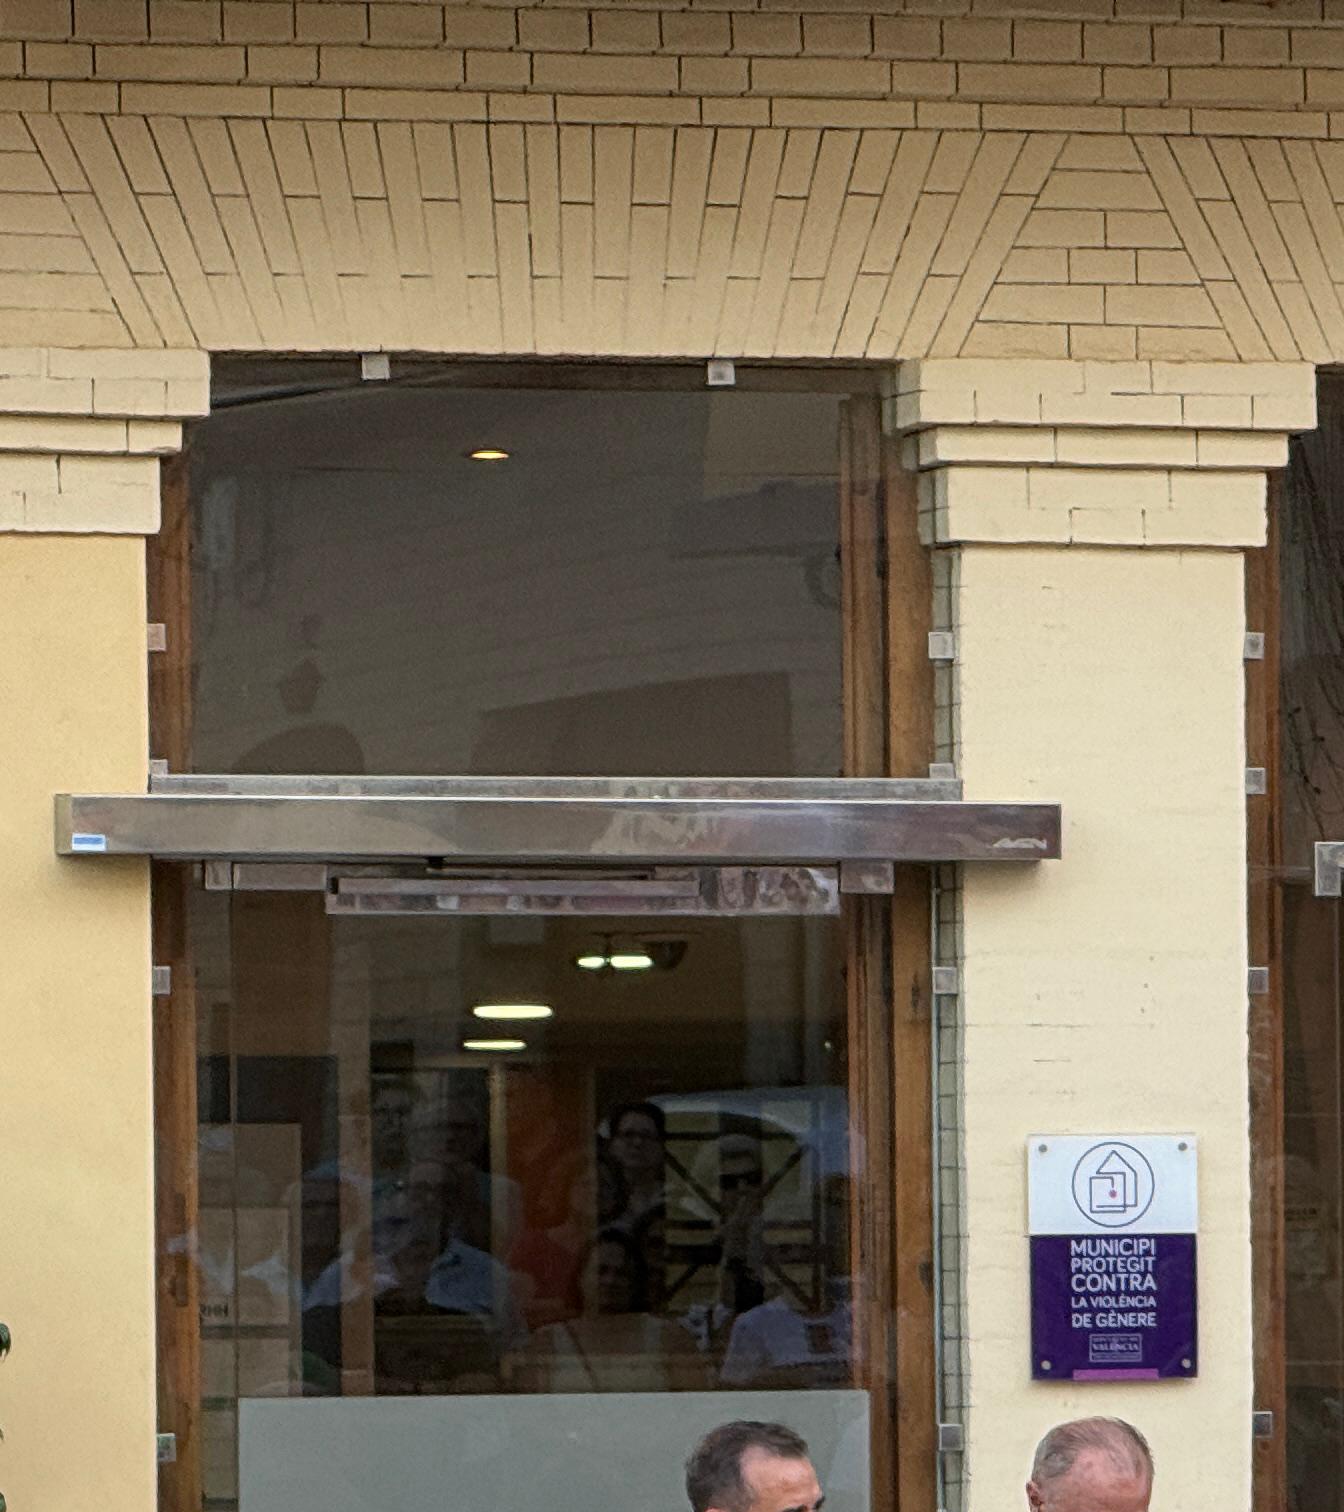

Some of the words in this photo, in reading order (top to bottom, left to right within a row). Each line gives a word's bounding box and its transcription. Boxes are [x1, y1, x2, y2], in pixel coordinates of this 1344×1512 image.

[1070, 1238, 1155, 1257] MUNICIPI
[1070, 1256, 1156, 1273] PROTEGIT
[1071, 1273, 1157, 1292] CONTRA
[1071, 1296, 1088, 1308] LA
[1071, 1313, 1092, 1328] DE
[1095, 1309, 1157, 1328] GÈNERE
